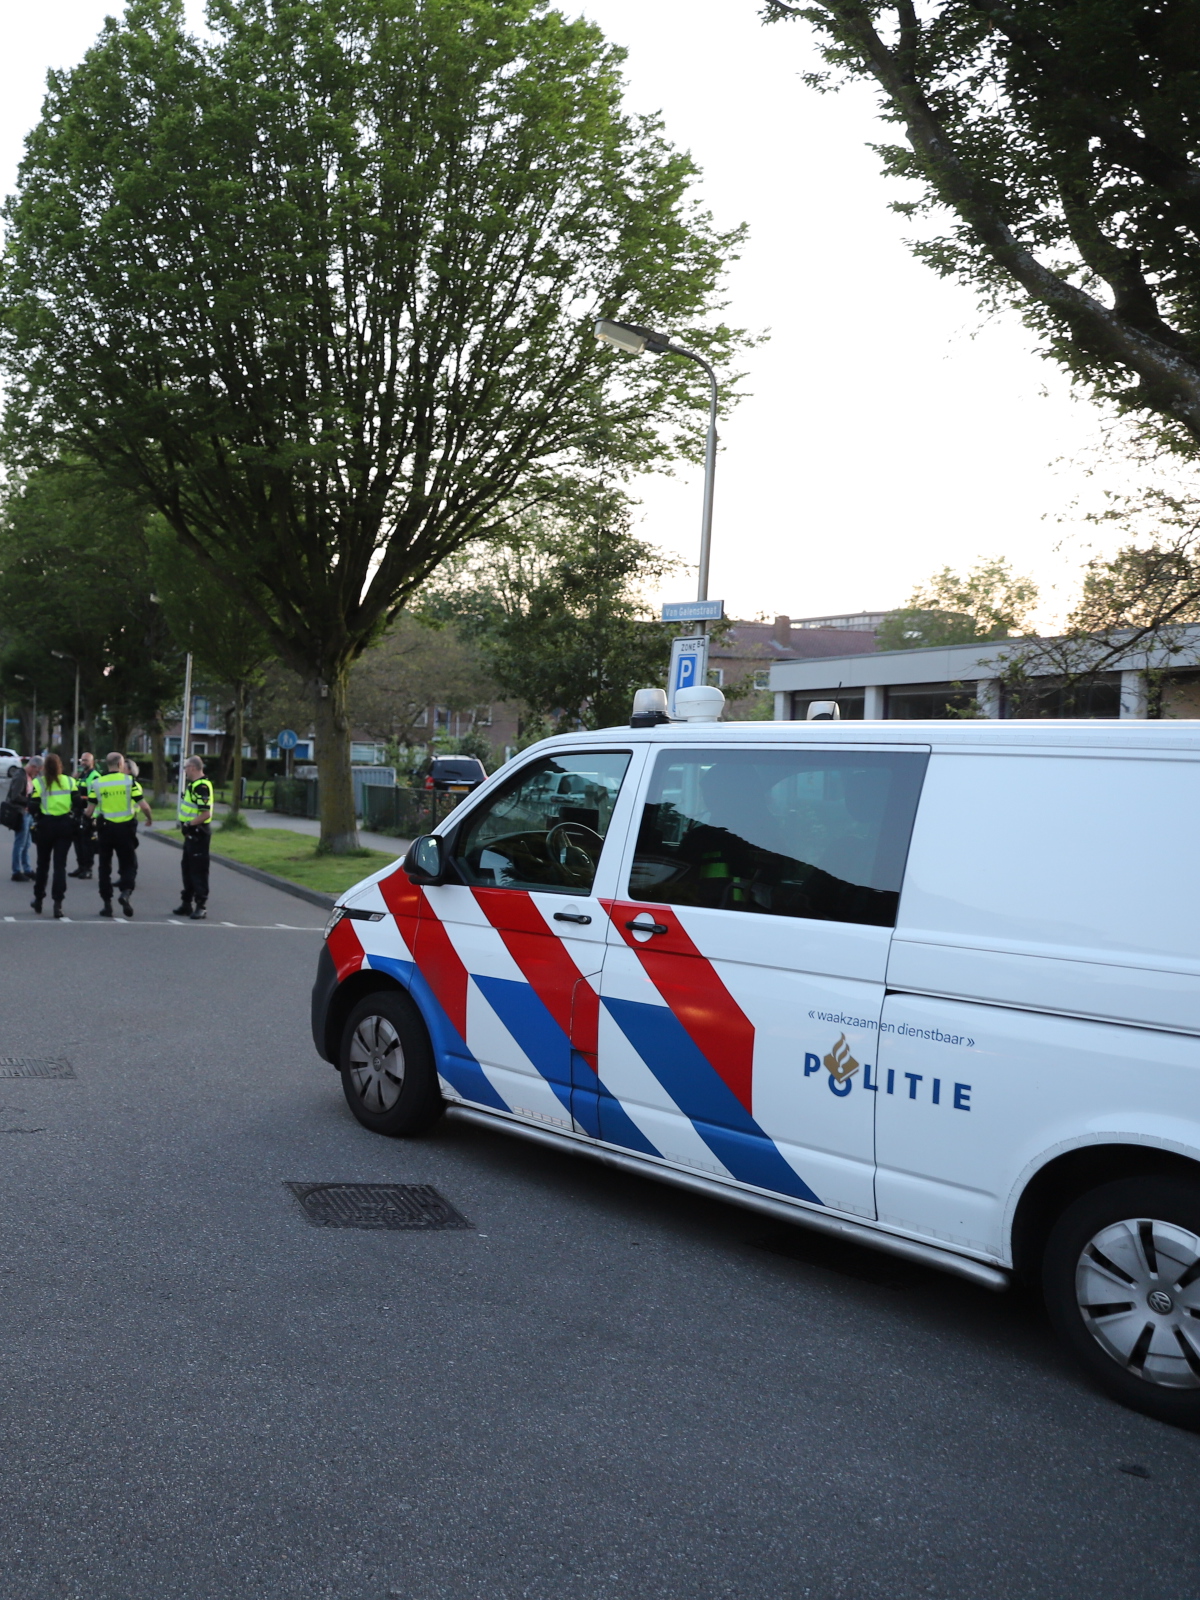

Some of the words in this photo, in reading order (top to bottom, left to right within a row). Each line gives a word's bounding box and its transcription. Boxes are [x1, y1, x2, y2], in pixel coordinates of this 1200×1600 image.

[665, 608, 678, 617] Van
[679, 605, 717, 617] Galenstraat
[681, 643, 696, 652] ZONE
[681, 660, 692, 688] P
[817, 1011, 879, 1031] waakzaam
[880, 1022, 895, 1034] en
[897, 1023, 965, 1046] dienstbaar
[803, 1052, 972, 1112] POLITIE
